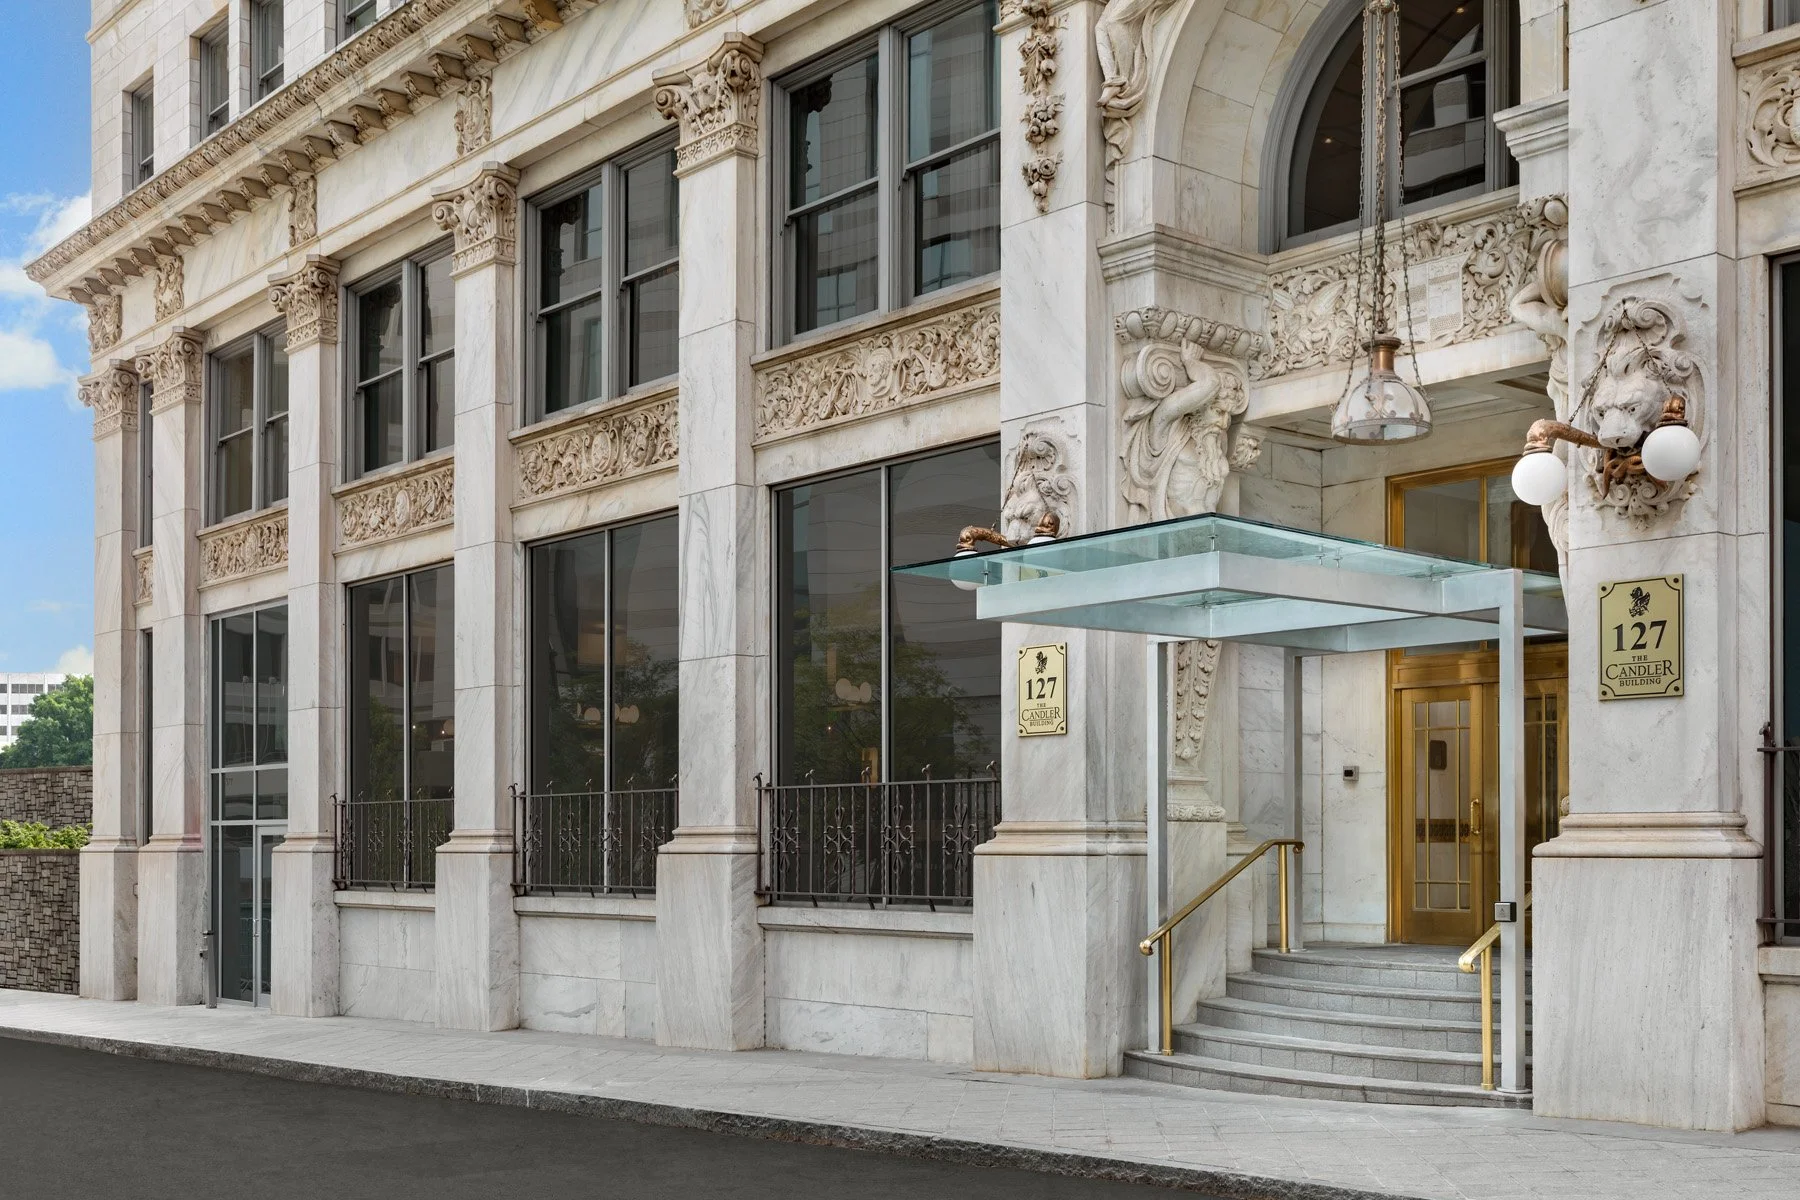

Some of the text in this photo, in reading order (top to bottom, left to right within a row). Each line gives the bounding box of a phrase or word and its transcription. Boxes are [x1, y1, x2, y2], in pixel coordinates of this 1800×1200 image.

[1612, 620, 1667, 652] 127
[1632, 654, 1648, 662] THE
[1605, 660, 1675, 680] CANDLER
[1026, 677, 1057, 700] 127
[1619, 678, 1661, 687] BUILDING
[1022, 706, 1061, 722] CANDLER
